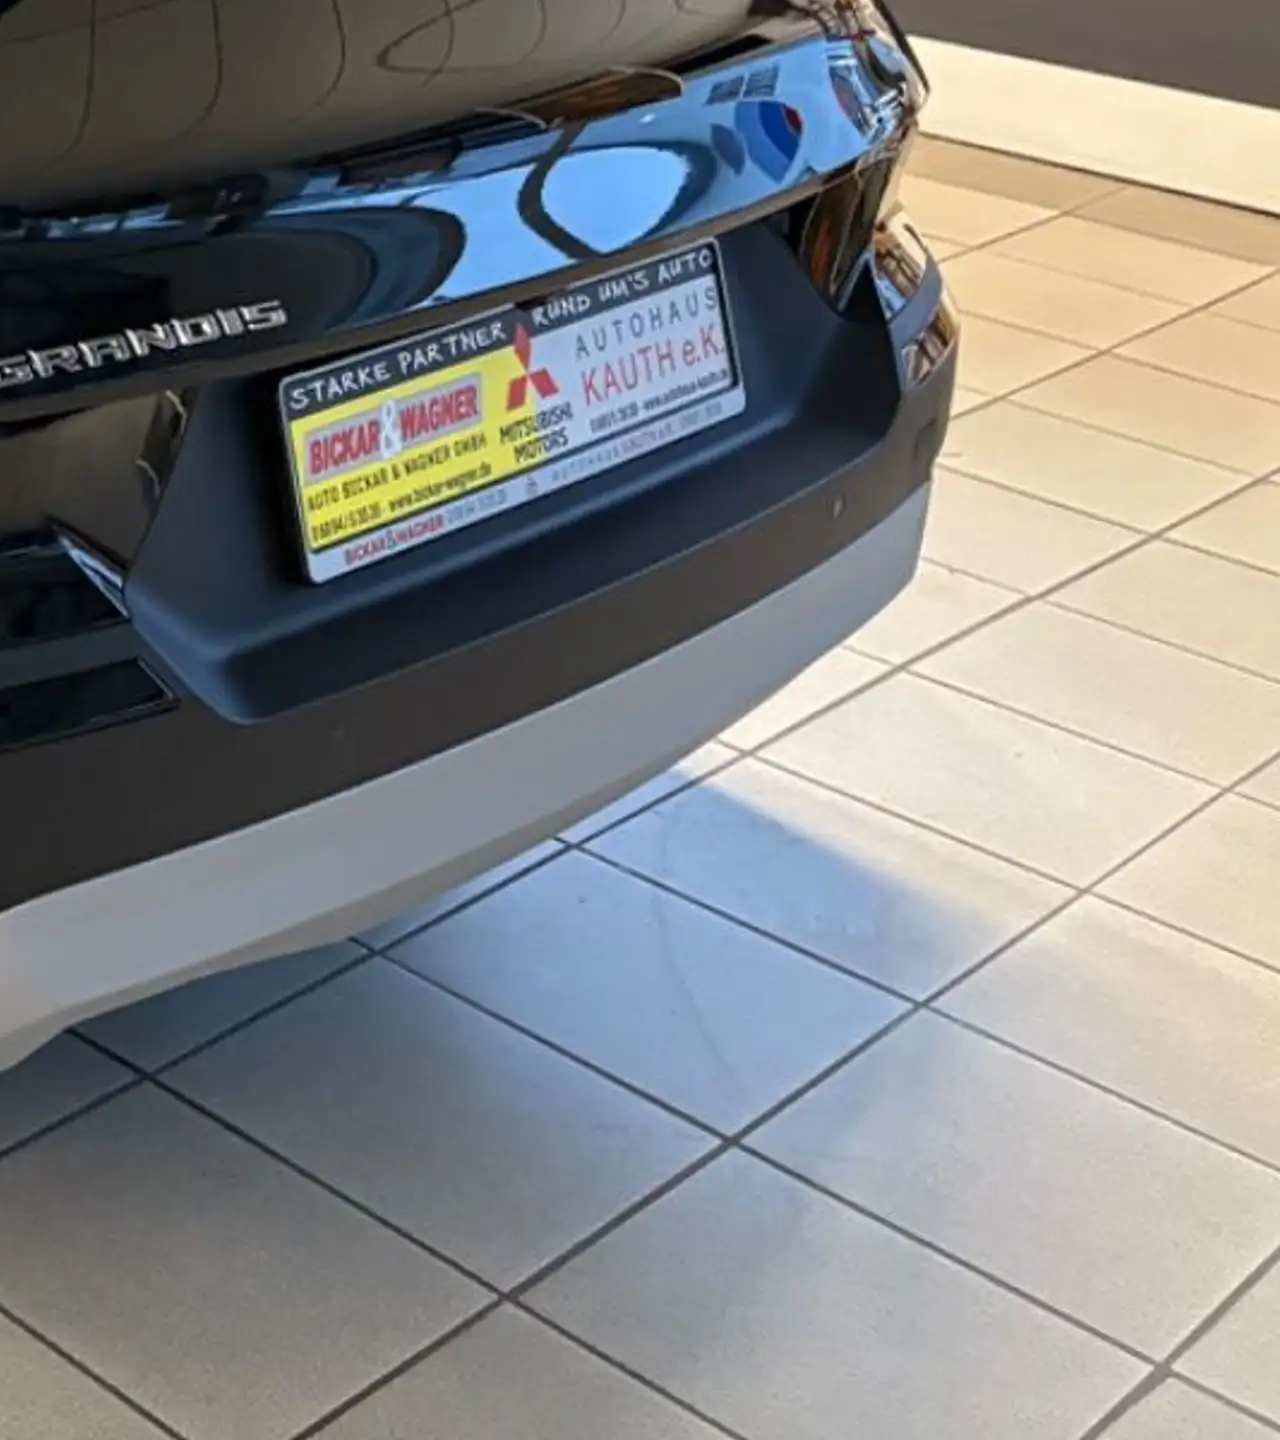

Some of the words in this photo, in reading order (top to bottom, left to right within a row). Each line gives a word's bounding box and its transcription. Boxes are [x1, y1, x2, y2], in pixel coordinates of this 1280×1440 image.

[290, 362, 392, 410] STARKE
[397, 322, 508, 376] PARTNER
[531, 296, 591, 327] RUND
[658, 249, 713, 283] AUTO
[575, 285, 718, 360] AUTOHAUS
[580, 339, 677, 407] KAUTH
[500, 401, 574, 445] MITSUBISHI
[513, 426, 569, 464] MOTORS
